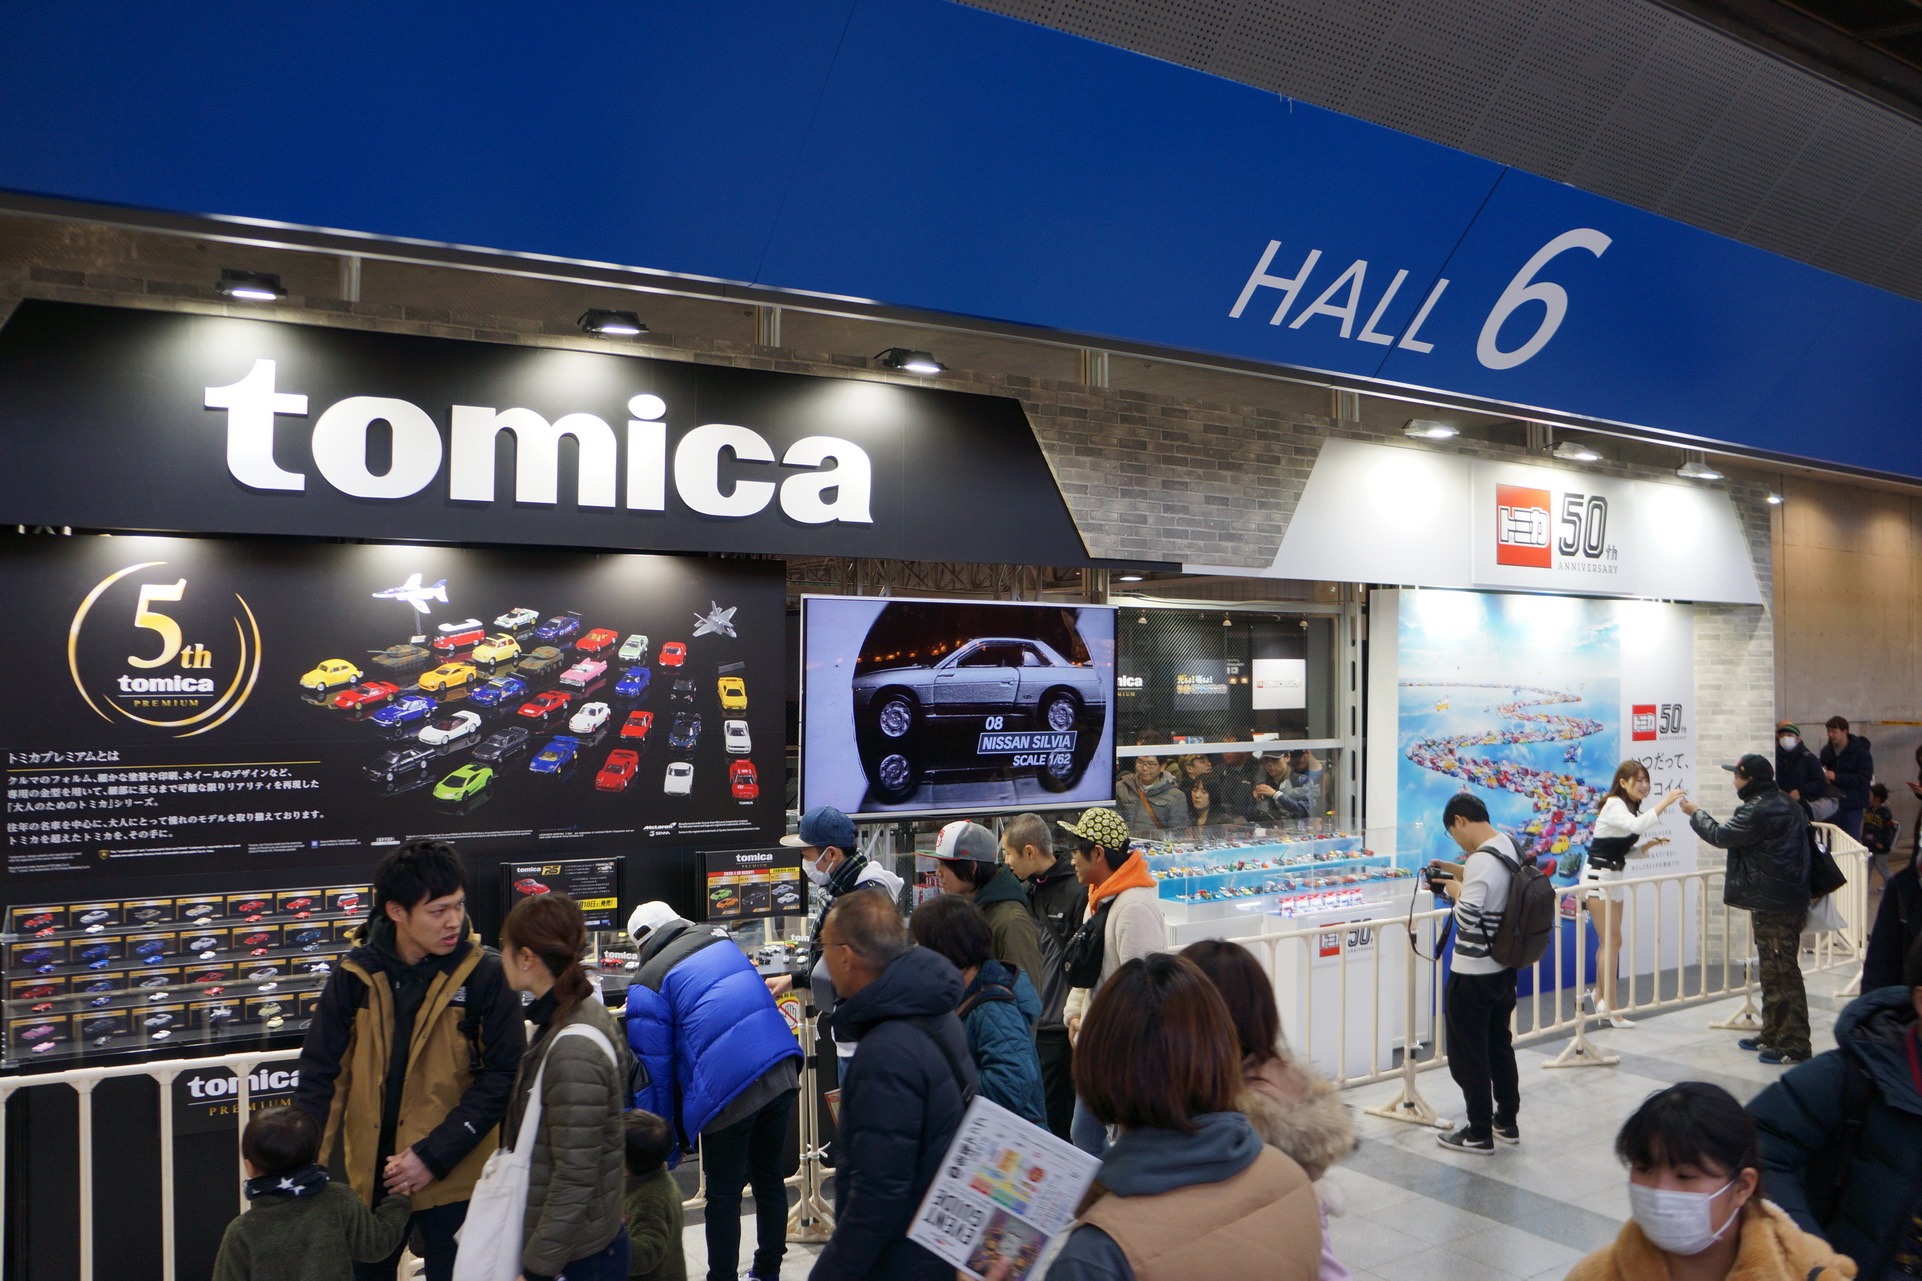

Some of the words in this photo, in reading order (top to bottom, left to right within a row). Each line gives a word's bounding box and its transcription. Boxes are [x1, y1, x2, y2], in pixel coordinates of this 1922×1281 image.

[1228, 239, 1450, 354] HALL
[1476, 228, 1613, 370] 6
[204, 358, 874, 525] tomica
[1557, 561, 1619, 575] ANNIVERSARY
[127, 578, 213, 669] 5th
[117, 674, 215, 693] tomica
[133, 699, 200, 708] PREMIUM
[985, 716, 1004, 730] 08
[982, 736, 1030, 749] NISSAN
[1032, 734, 1071, 748] SILVIA
[9, 751, 120, 764] トミカプレミアムとは
[1012, 754, 1046, 766] SCALE
[1048, 753, 1071, 765] 1/62
[9, 829, 174, 846] トミカを超えたトミカを、その手に。
[736, 853, 773, 862] tomica
[790, 933, 810, 942] tom
[603, 950, 638, 960] tomica
